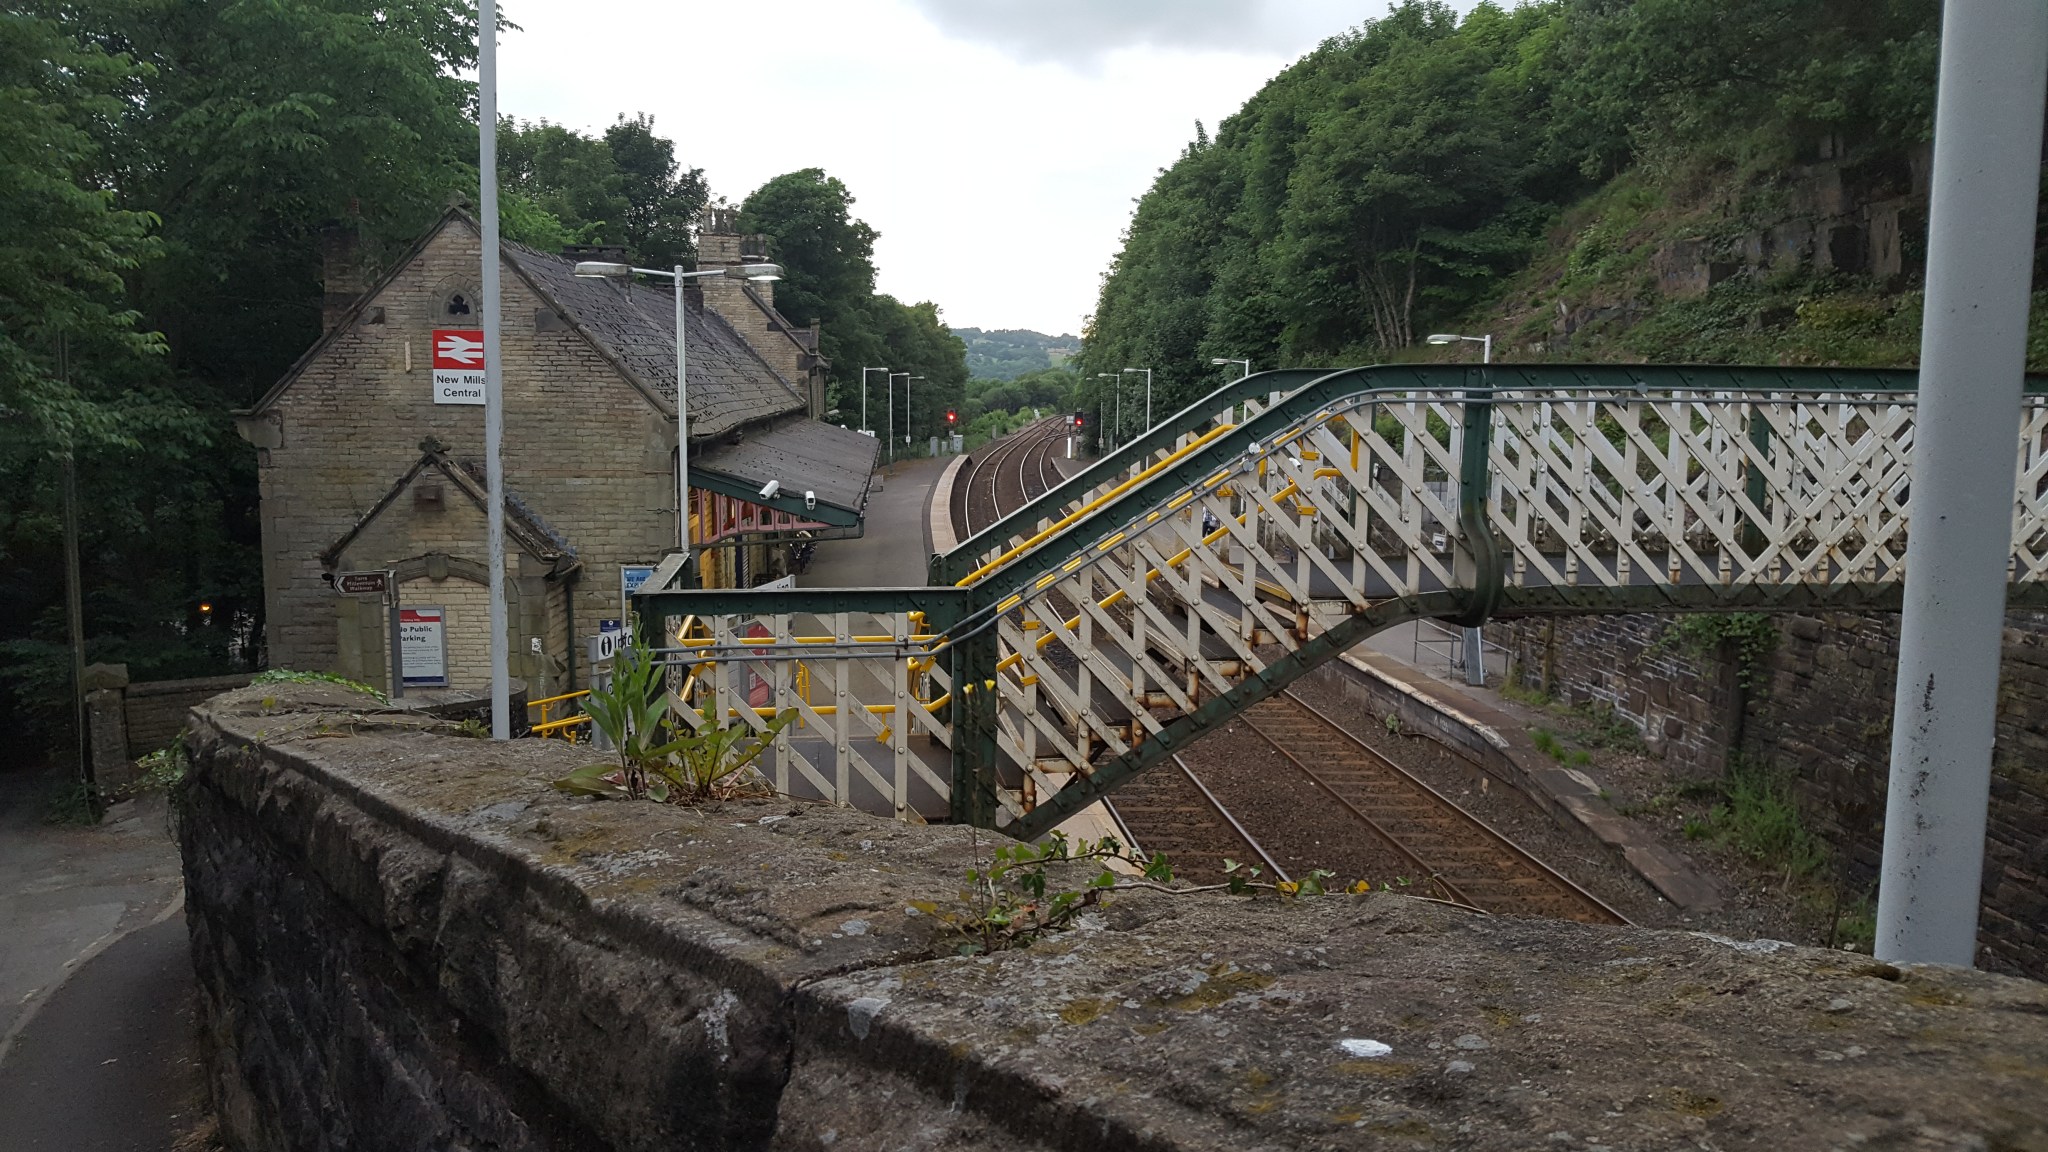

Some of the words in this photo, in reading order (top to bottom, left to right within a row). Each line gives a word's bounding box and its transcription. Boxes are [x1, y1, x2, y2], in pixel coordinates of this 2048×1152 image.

[436, 375, 459, 384] New
[463, 375, 486, 385] Mills
[443, 388, 481, 397] Central
[400, 634, 427, 643] arking
